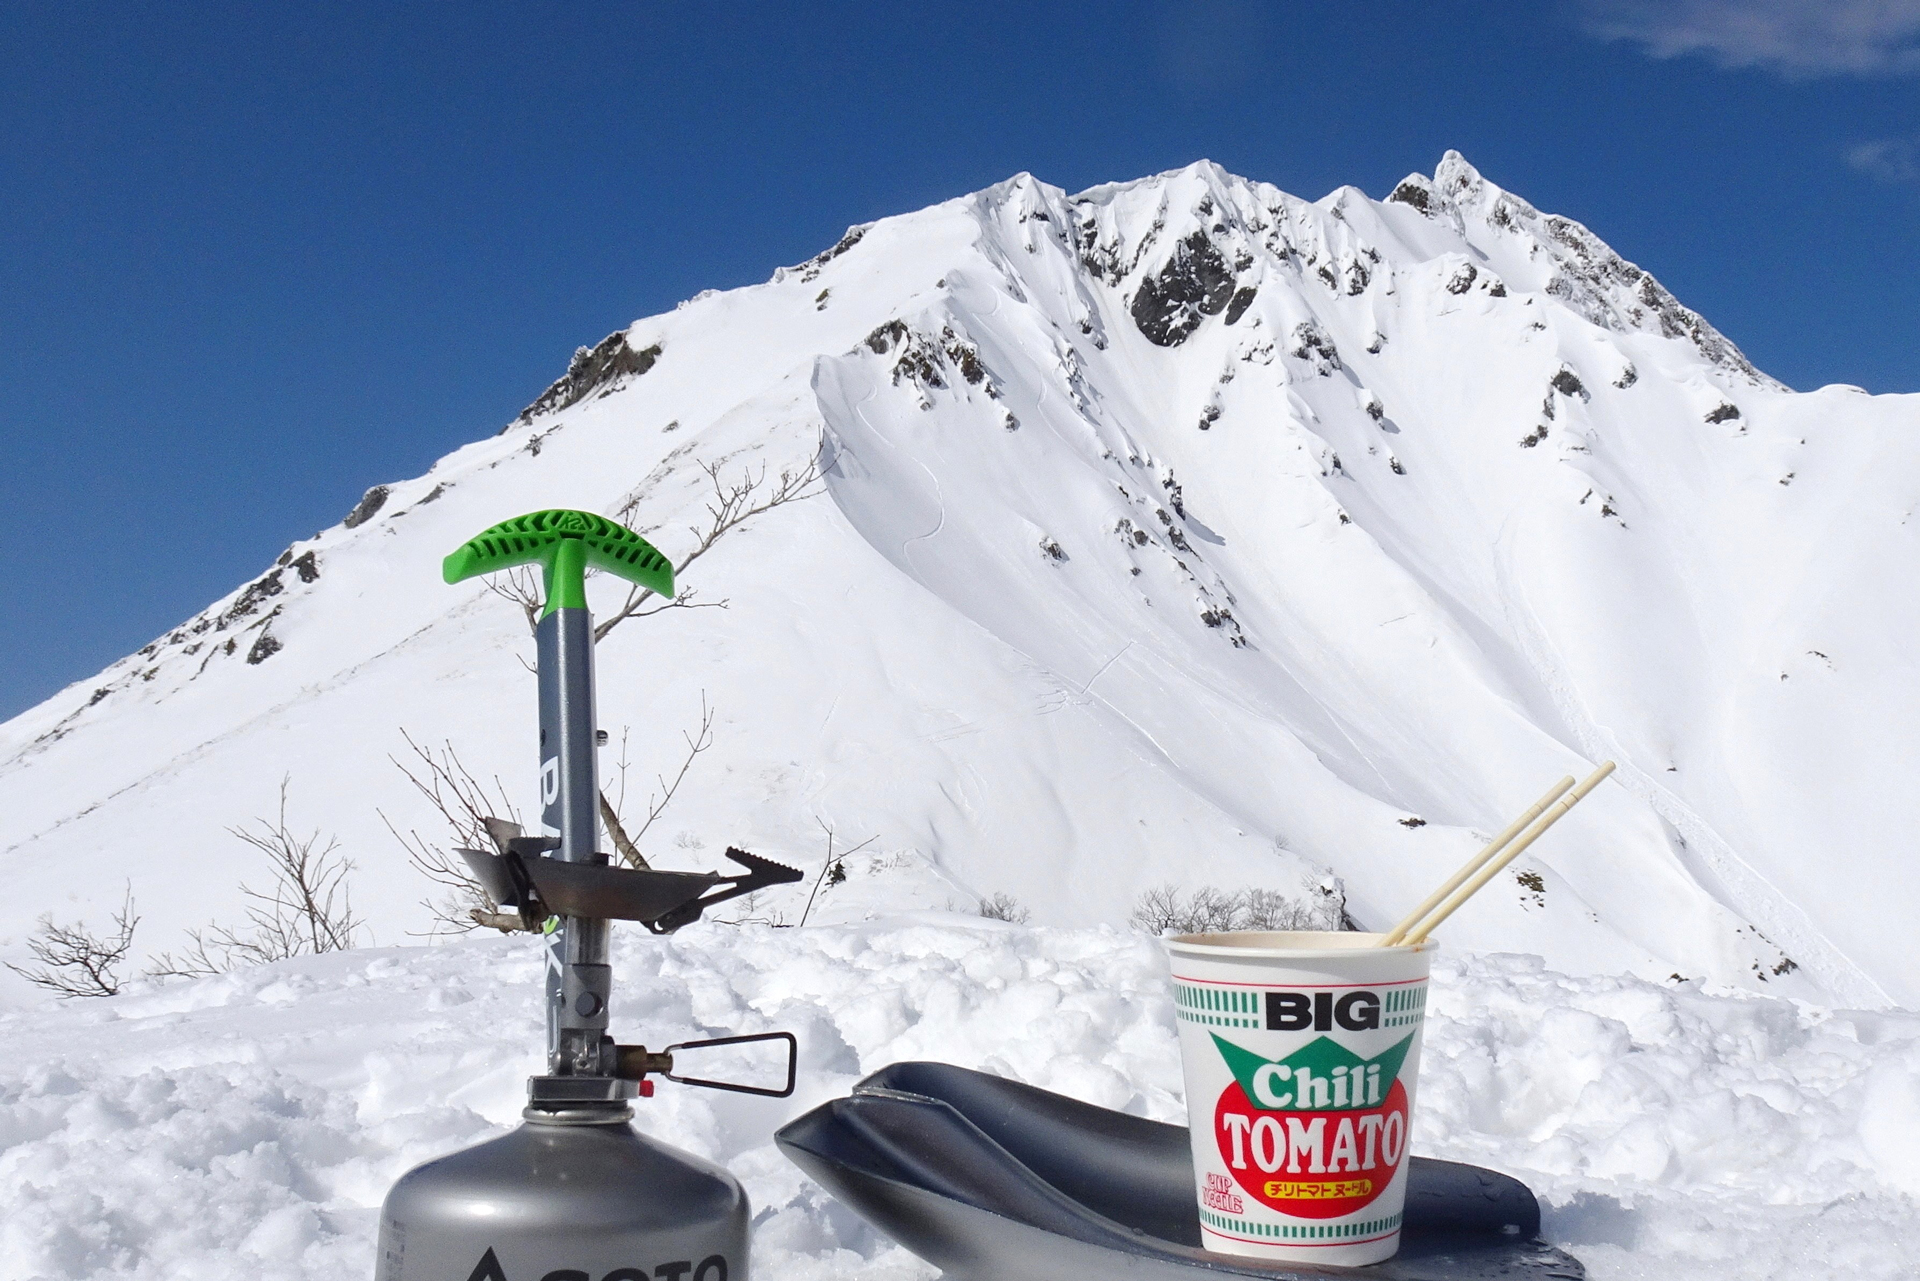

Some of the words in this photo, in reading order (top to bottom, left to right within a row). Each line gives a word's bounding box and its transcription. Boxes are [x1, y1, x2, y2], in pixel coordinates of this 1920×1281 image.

[1265, 991, 1380, 1031] BIG
[1252, 1062, 1381, 1109] Chili
[1223, 1110, 1404, 1173] TOMATO
[1206, 1171, 1233, 1194] CUP
